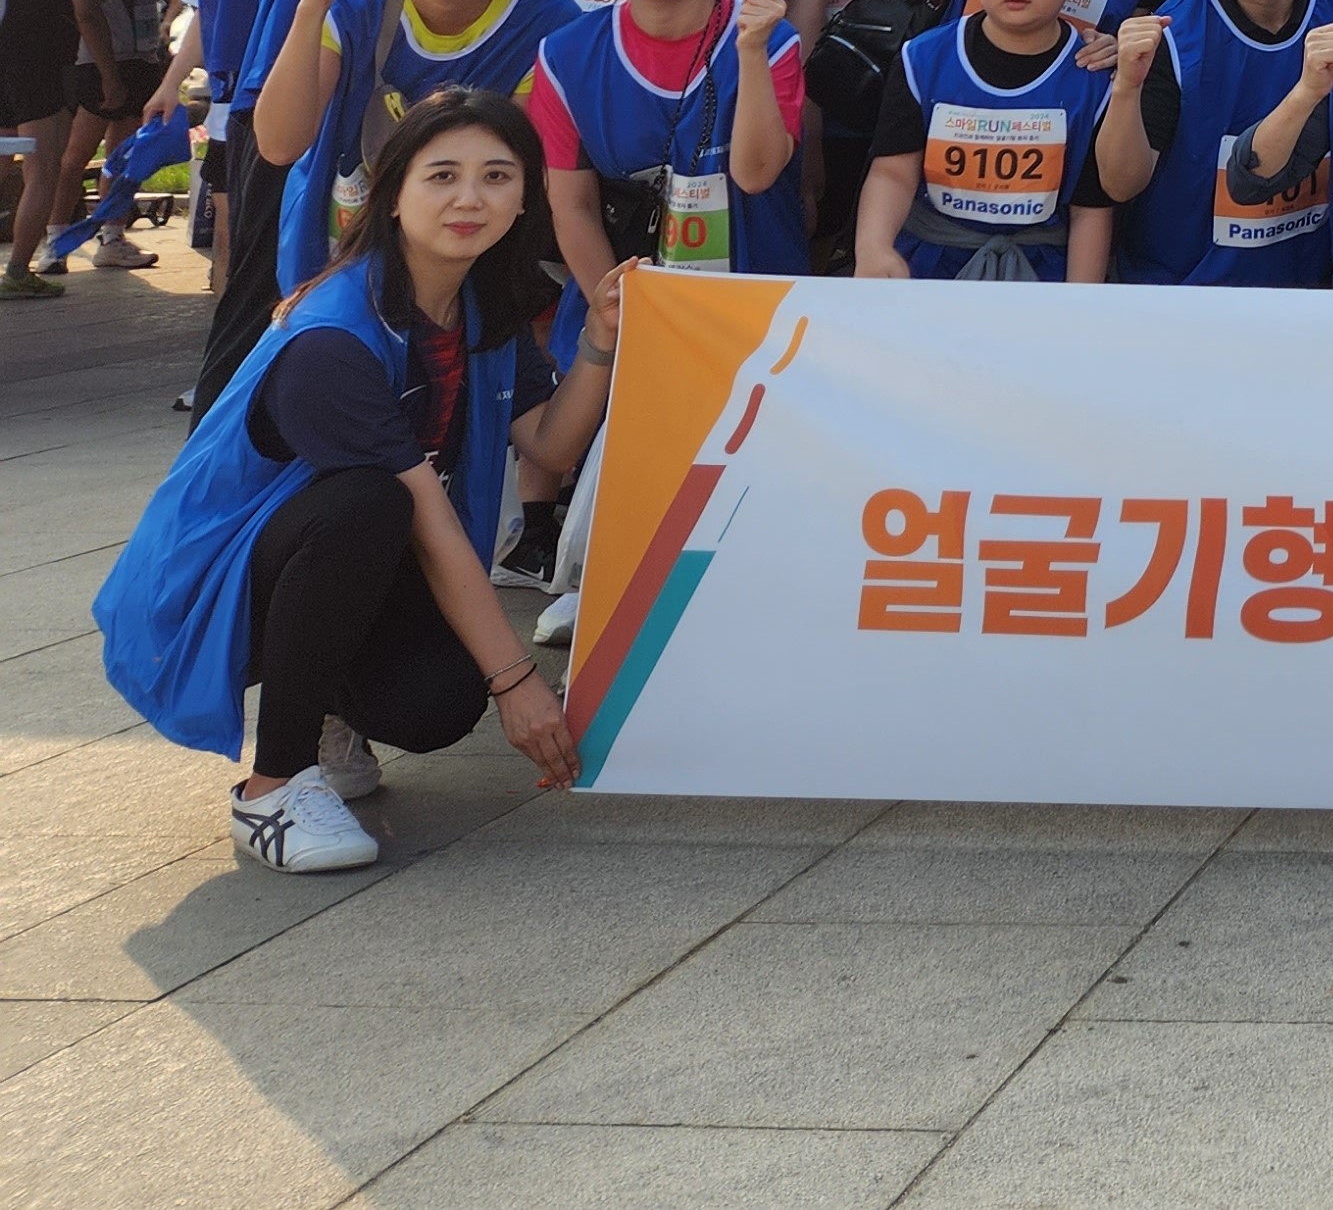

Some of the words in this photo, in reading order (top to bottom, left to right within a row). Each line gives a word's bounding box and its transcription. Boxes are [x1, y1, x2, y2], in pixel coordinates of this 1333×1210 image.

[944, 146, 1044, 180] 9102
[941, 192, 1044, 215] Panasonic
[1229, 212, 1322, 240] Panasonic
